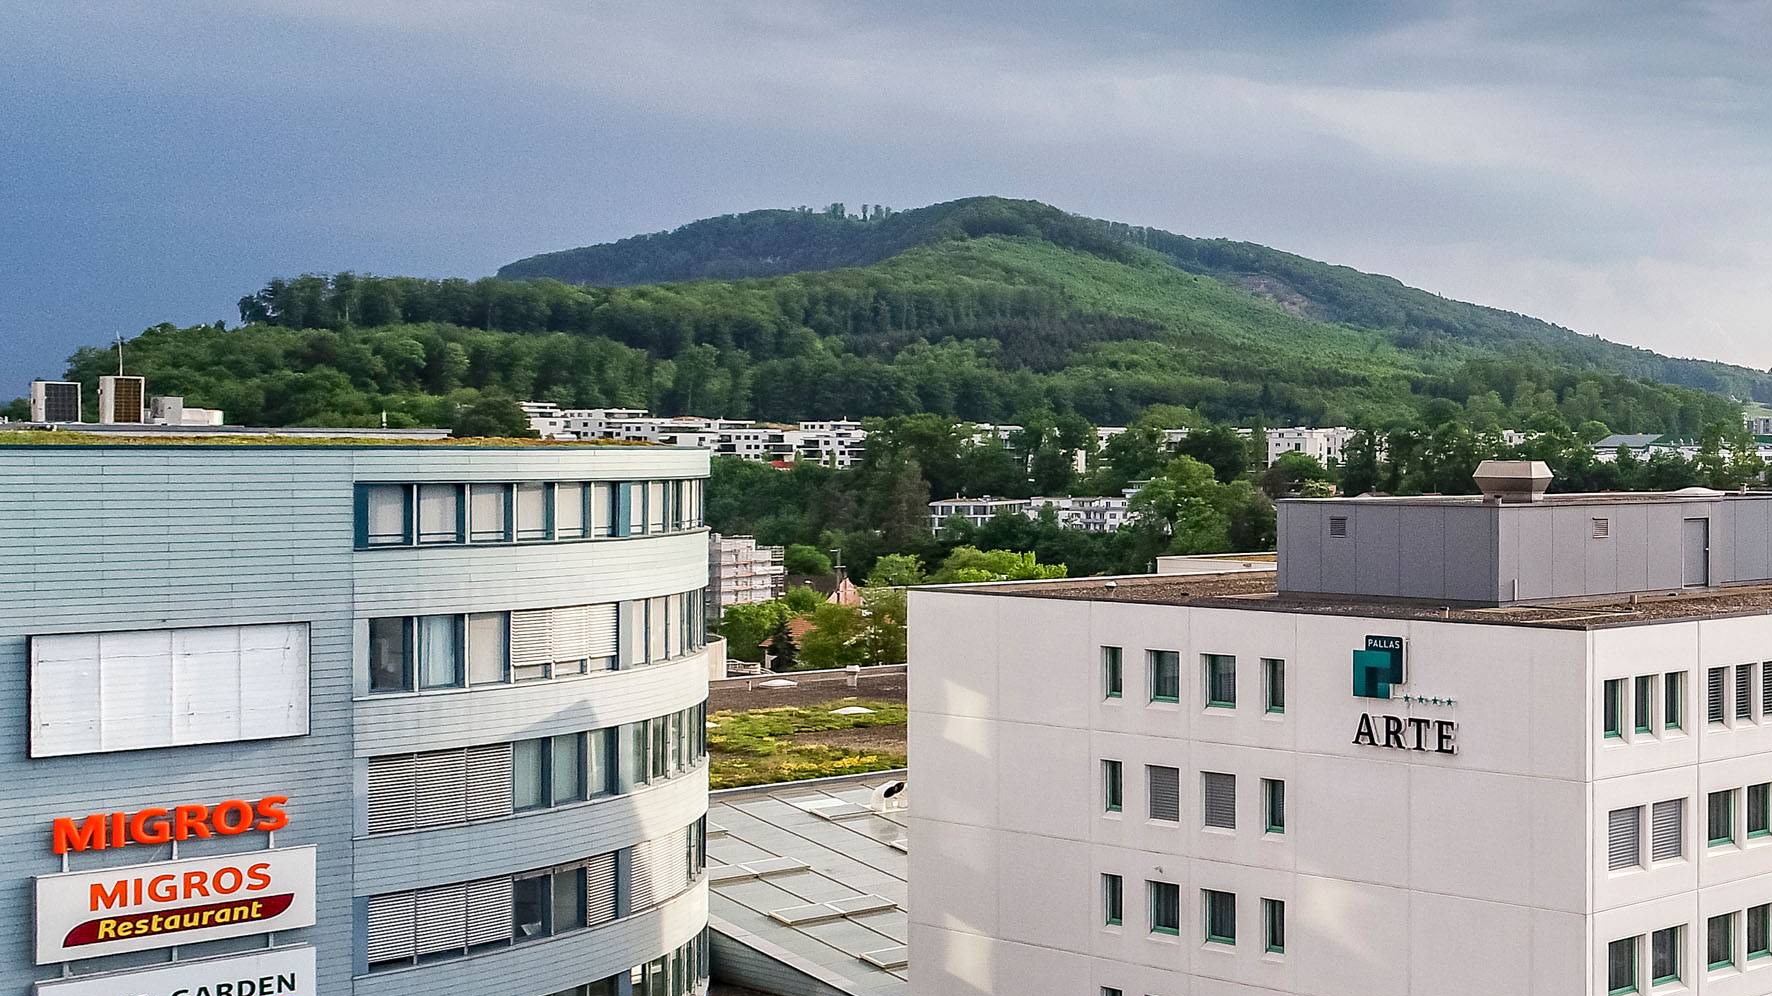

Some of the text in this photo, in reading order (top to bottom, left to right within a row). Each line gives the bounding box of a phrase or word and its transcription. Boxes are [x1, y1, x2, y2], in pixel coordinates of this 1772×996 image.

[1367, 639, 1400, 649] PALLAS
[1351, 712, 1456, 755] ARTE
[51, 795, 290, 855] MIGROS
[89, 862, 272, 912] MIGROS
[97, 900, 264, 941] Restaurant
